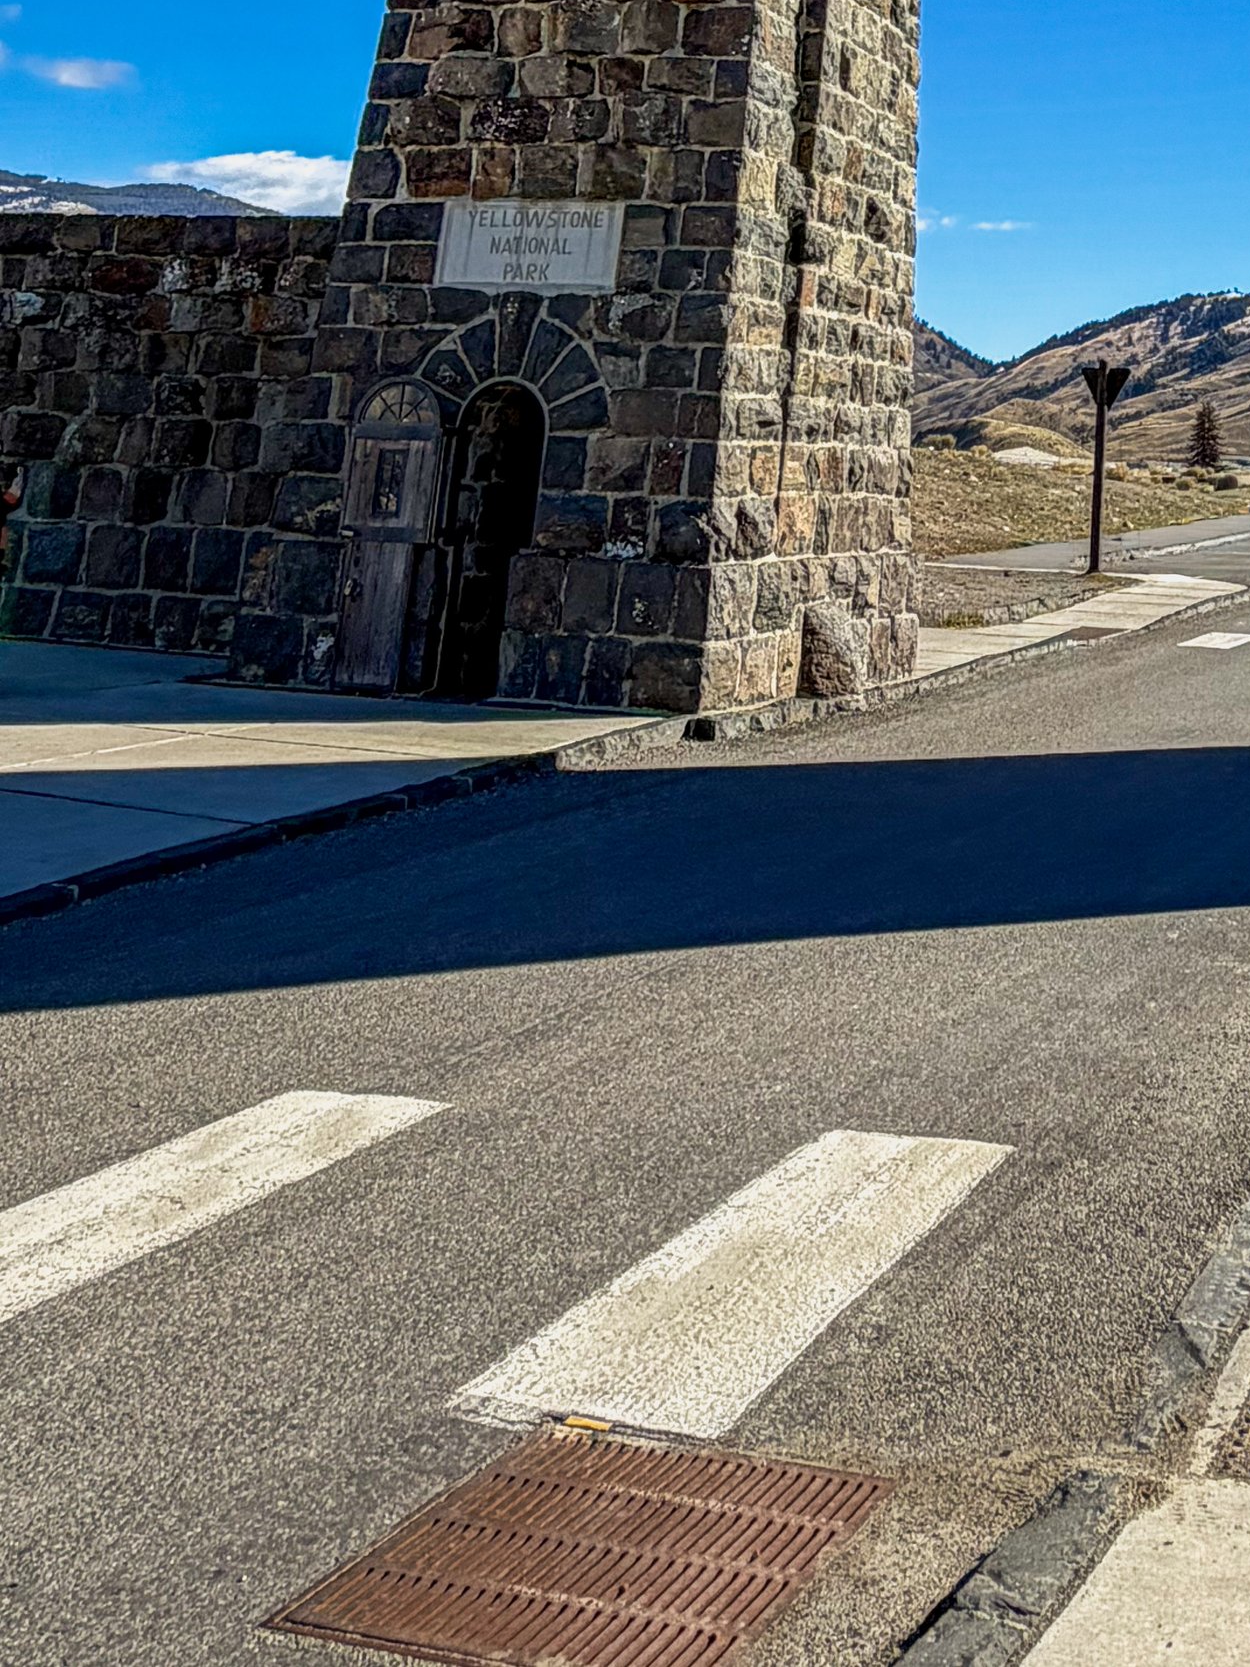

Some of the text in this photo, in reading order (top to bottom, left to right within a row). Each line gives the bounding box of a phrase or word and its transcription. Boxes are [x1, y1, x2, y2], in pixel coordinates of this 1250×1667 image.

[469, 210, 604, 228] YELLOWSTONE
[490, 237, 572, 255] NATIONAL
[503, 264, 549, 281] PARK
